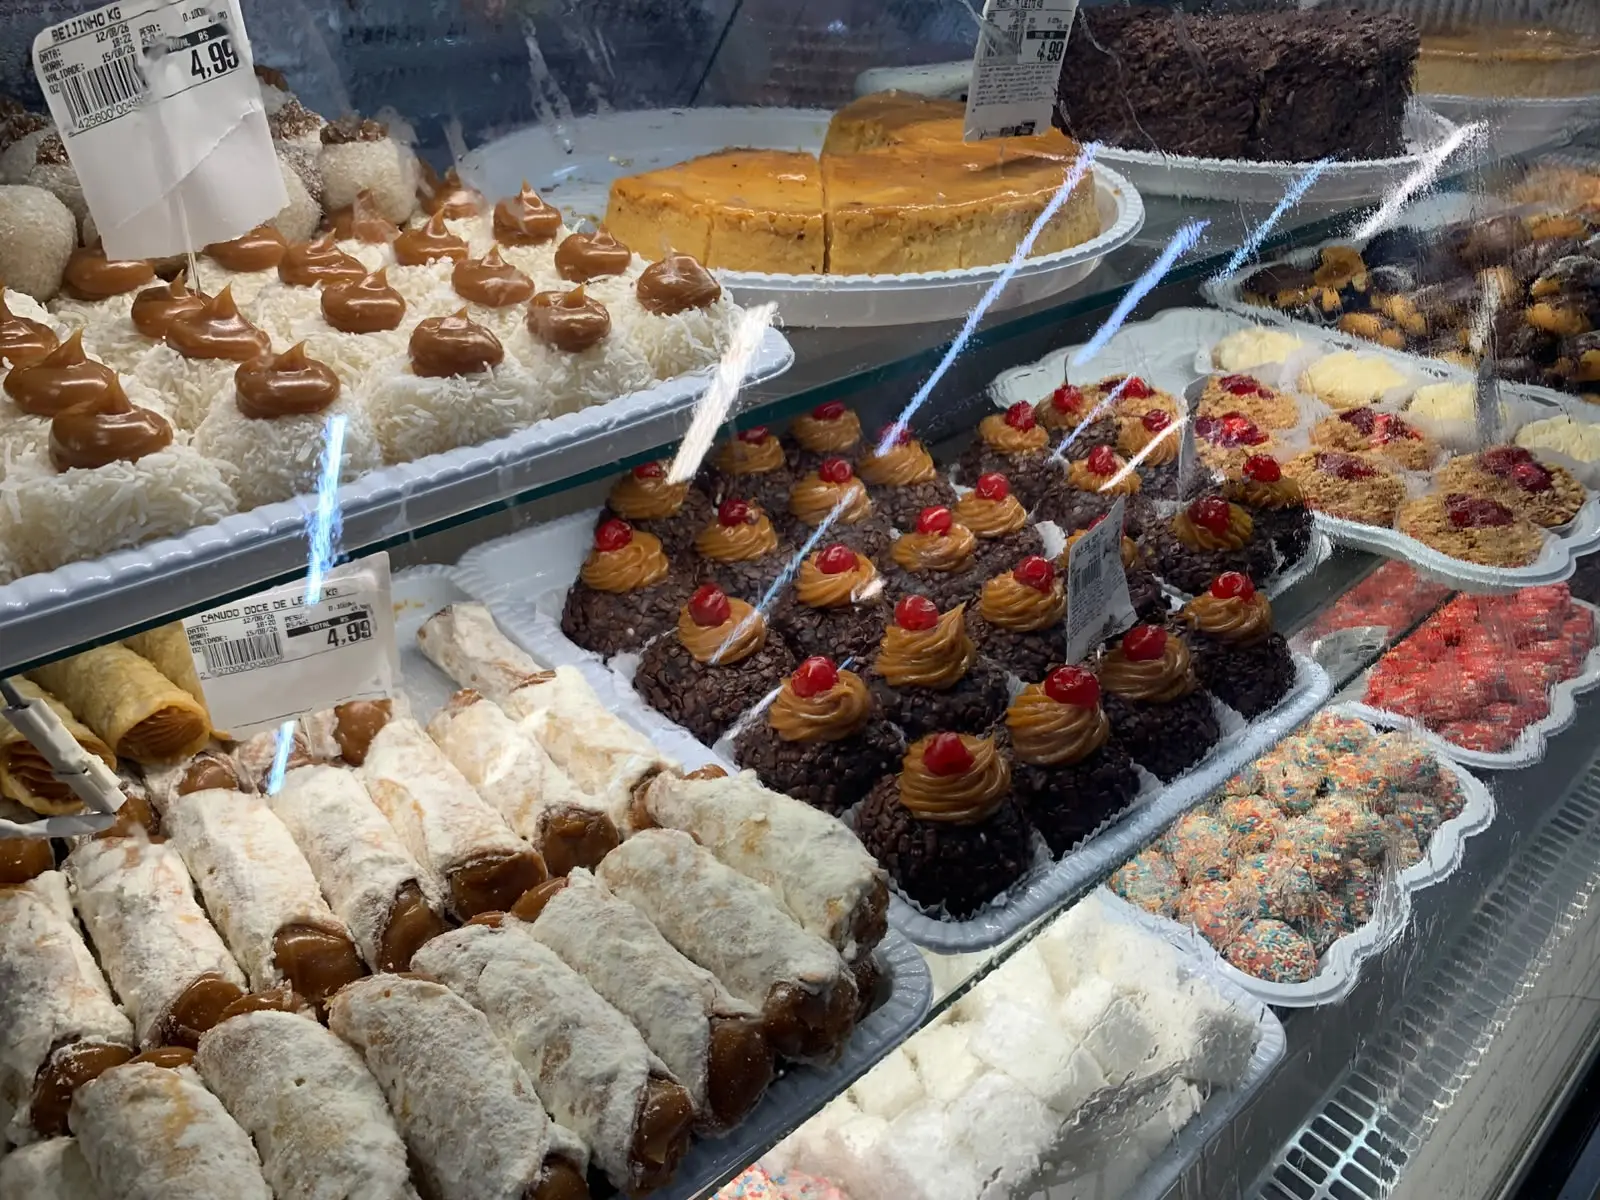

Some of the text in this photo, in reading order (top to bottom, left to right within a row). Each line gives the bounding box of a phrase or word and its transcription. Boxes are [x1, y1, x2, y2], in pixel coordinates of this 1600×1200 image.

[51, 7, 122, 42] BEIJINHO KG
[38, 48, 62, 64] DATA:
[191, 39, 240, 80] 4,99
[78, 108, 114, 129] 425600
[201, 587, 338, 624] CANUDO DOCE DE KG
[327, 619, 372, 647] 4,99
